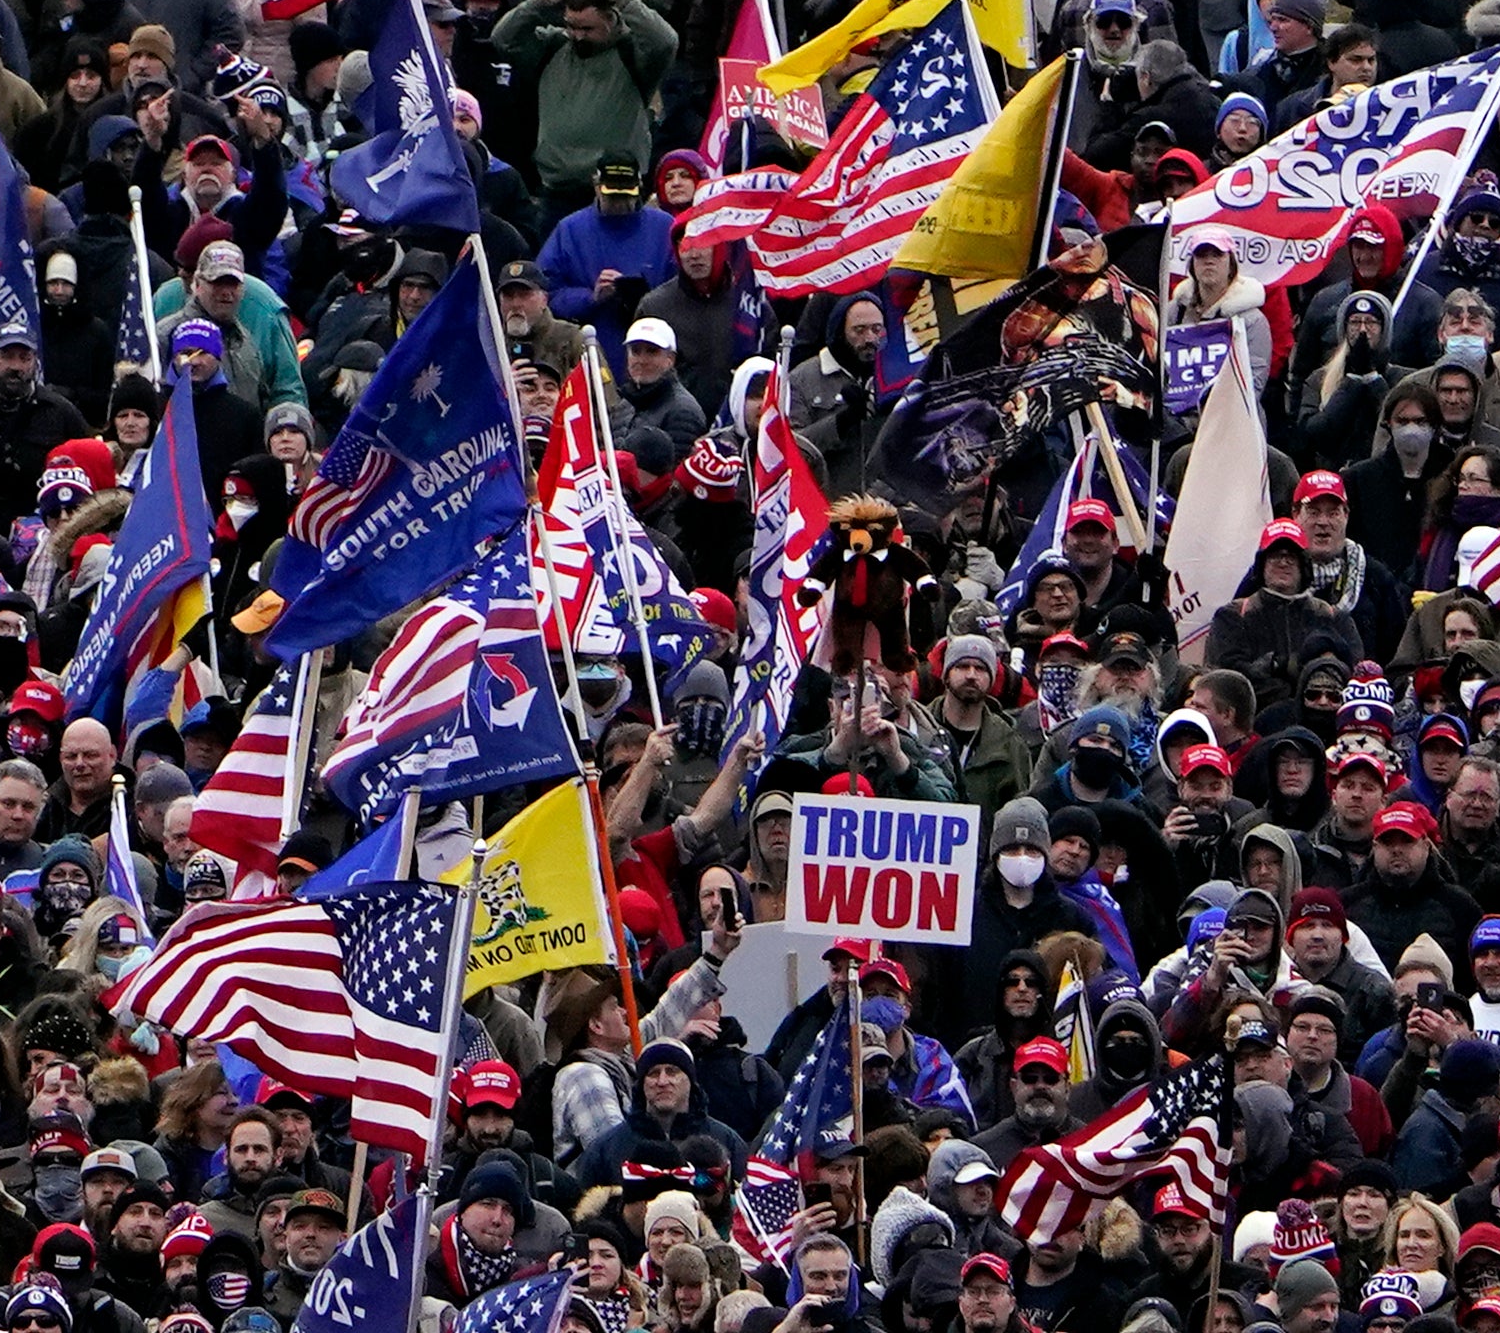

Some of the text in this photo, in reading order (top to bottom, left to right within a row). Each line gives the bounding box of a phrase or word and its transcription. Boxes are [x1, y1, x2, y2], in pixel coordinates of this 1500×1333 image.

[726, 84, 824, 126] AMERICA
[328, 423, 508, 571] SOUTH CAROLINA
[372, 518, 427, 563] FOR
[801, 805, 969, 864] TRUMP
[803, 865, 960, 943] WON
